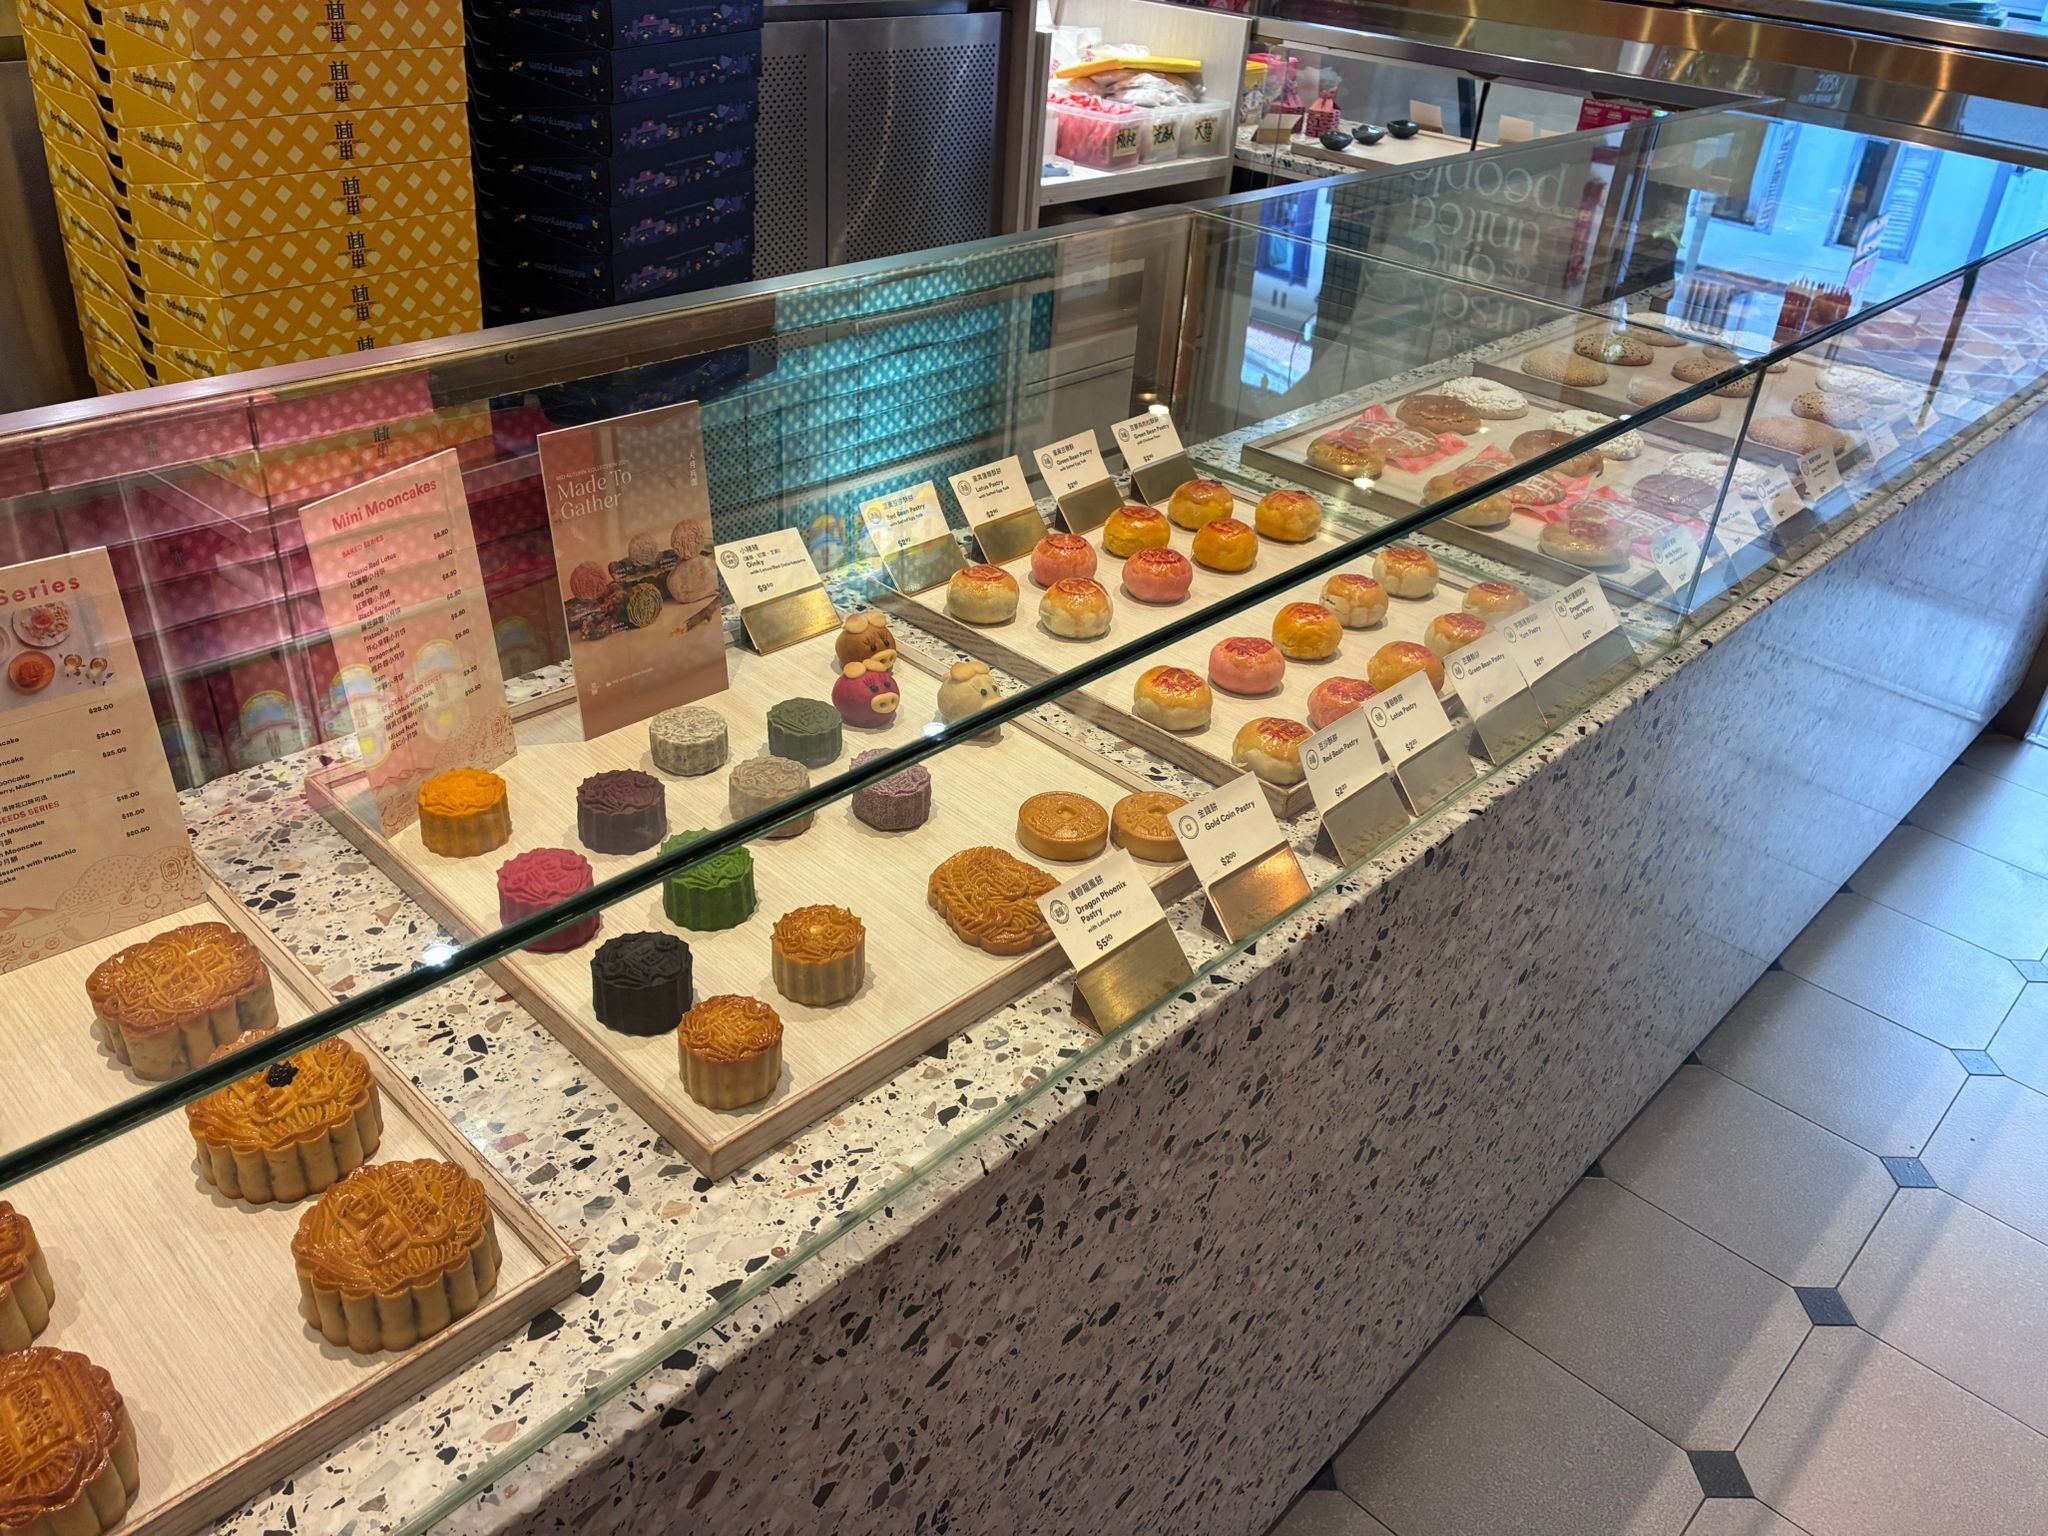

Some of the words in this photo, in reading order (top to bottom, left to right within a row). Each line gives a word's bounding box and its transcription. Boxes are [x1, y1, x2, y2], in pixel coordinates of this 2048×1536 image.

[1408, 195, 1539, 257] united
[1056, 458, 1069, 466] Green
[1079, 449, 1092, 457] Pastry
[557, 474, 607, 501] Made
[610, 469, 632, 486] To
[975, 484, 989, 492] Lotus
[989, 480, 1004, 488] Pastry
[331, 507, 363, 531] Mini
[365, 480, 437, 518] Mooncakes
[561, 493, 622, 520] Gather
[909, 504, 925, 512] Pastry
[342, 544, 363, 558] BAKED
[363, 535, 384, 550] SERIES
[347, 566, 368, 579] Classic
[369, 560, 379, 569] Red
[381, 553, 397, 563] Lotus
[746, 560, 764, 568] Oinky
[352, 591, 364, 600] Red
[365, 585, 379, 595] Date
[358, 609, 374, 620] Black
[374, 600, 396, 613] Sesame
[1569, 598, 1589, 614] Dragonwell
[1573, 612, 1584, 620] Lotus
[1582, 606, 1595, 615] Pastry
[363, 626, 389, 643] Pistachio
[1528, 626, 1541, 635] Pastry
[368, 643, 400, 663] Dragonwell
[1468, 666, 1481, 675] Green
[1491, 654, 1505, 663] Pastry
[374, 674, 386, 683] Yam
[88, 703, 114, 714] $28.00
[384, 713, 394, 721] Red
[395, 704, 410, 716] Lotus
[410, 697, 422, 707] with
[422, 690, 434, 699] Yolk
[1390, 711, 1403, 721] Lotus
[1402, 702, 1417, 713] Pastry
[96, 728, 121, 740] $24.00
[388, 728, 405, 741] Mixed
[405, 721, 418, 731] Nuts
[102, 747, 127, 758] $25.00
[1323, 753, 1332, 763] Red
[1332, 748, 1344, 757] Bean
[1343, 738, 1359, 751] Pastry
[15, 779, 45, 790] Mulberry
[53, 770, 75, 779] Roselle
[116, 791, 140, 802] $18.00
[28, 800, 60, 815] SERIES
[121, 808, 145, 820] $18.00
[1204, 817, 1220, 831] Gold
[1220, 811, 1236, 823] Coin
[1235, 801, 1255, 815] Pastry
[7, 820, 45, 835] Mooncake
[126, 826, 150, 838] $20.00
[5, 841, 42, 856] Mooncake
[26, 859, 42, 868] with
[44, 849, 76, 862] Pistachio
[1075, 897, 1100, 915] Dragon
[1100, 880, 1127, 900] Phoenix
[1081, 907, 1103, 924] Pastry
[1088, 925, 1098, 933] with
[1097, 917, 1110, 928] Lotus
[1110, 909, 1122, 919] Paste
